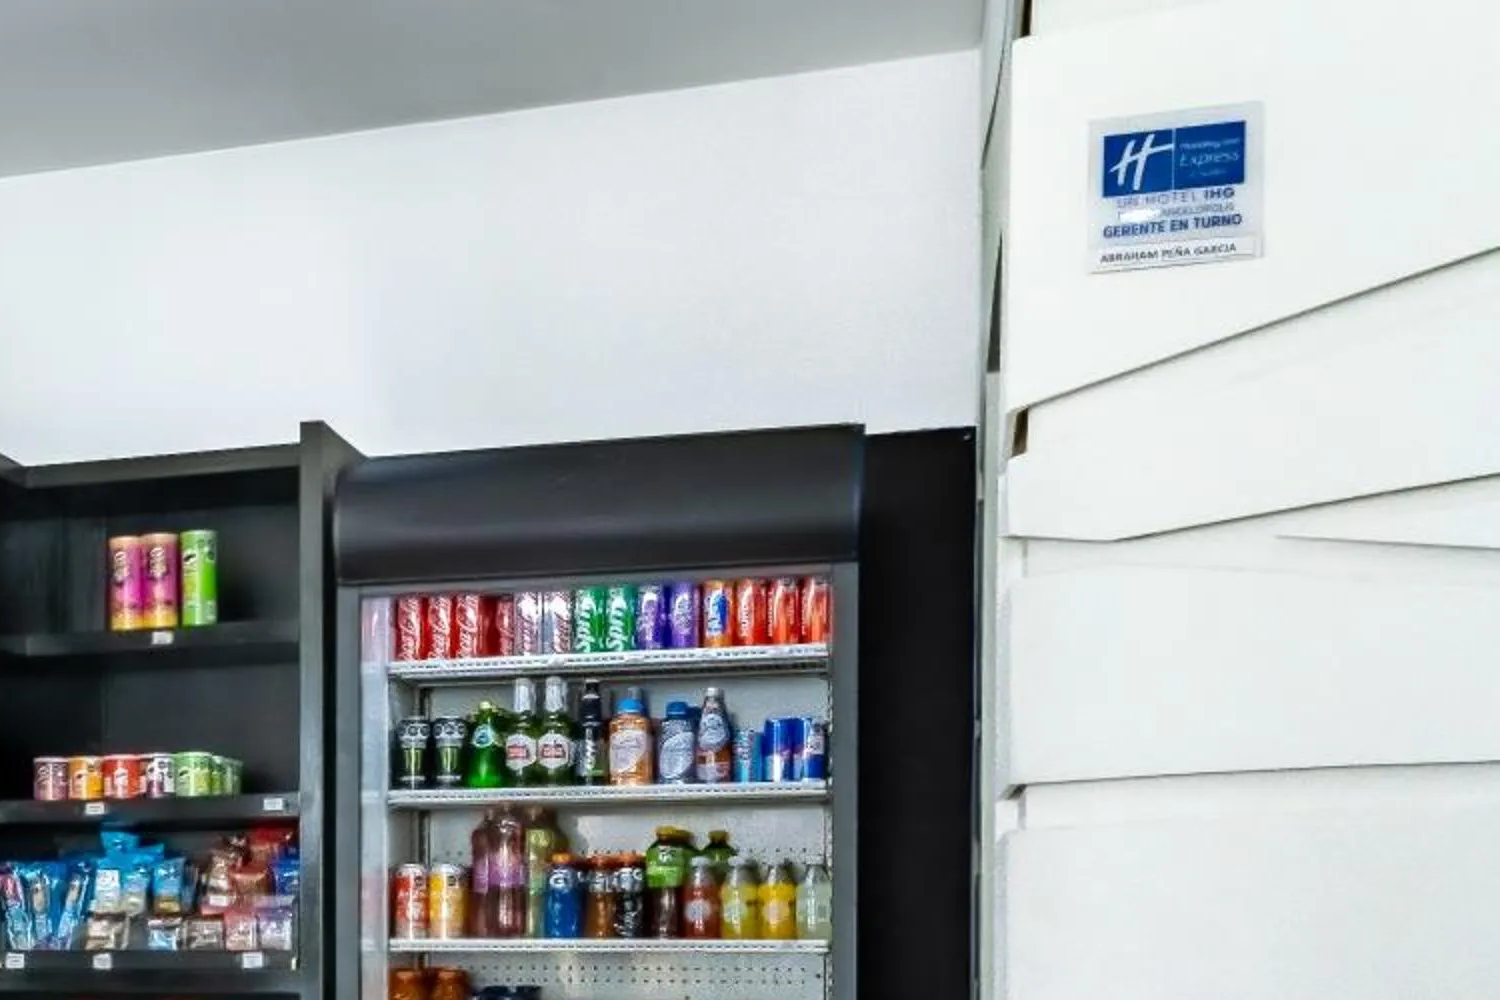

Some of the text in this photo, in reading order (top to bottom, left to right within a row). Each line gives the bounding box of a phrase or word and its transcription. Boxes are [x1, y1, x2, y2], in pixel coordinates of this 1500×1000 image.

[1145, 192, 1197, 204] HOTEL
[1204, 187, 1235, 199] IHG
[1103, 213, 1243, 239] GERENTE EN TURNO
[1100, 249, 1159, 263] ABRAHAM
